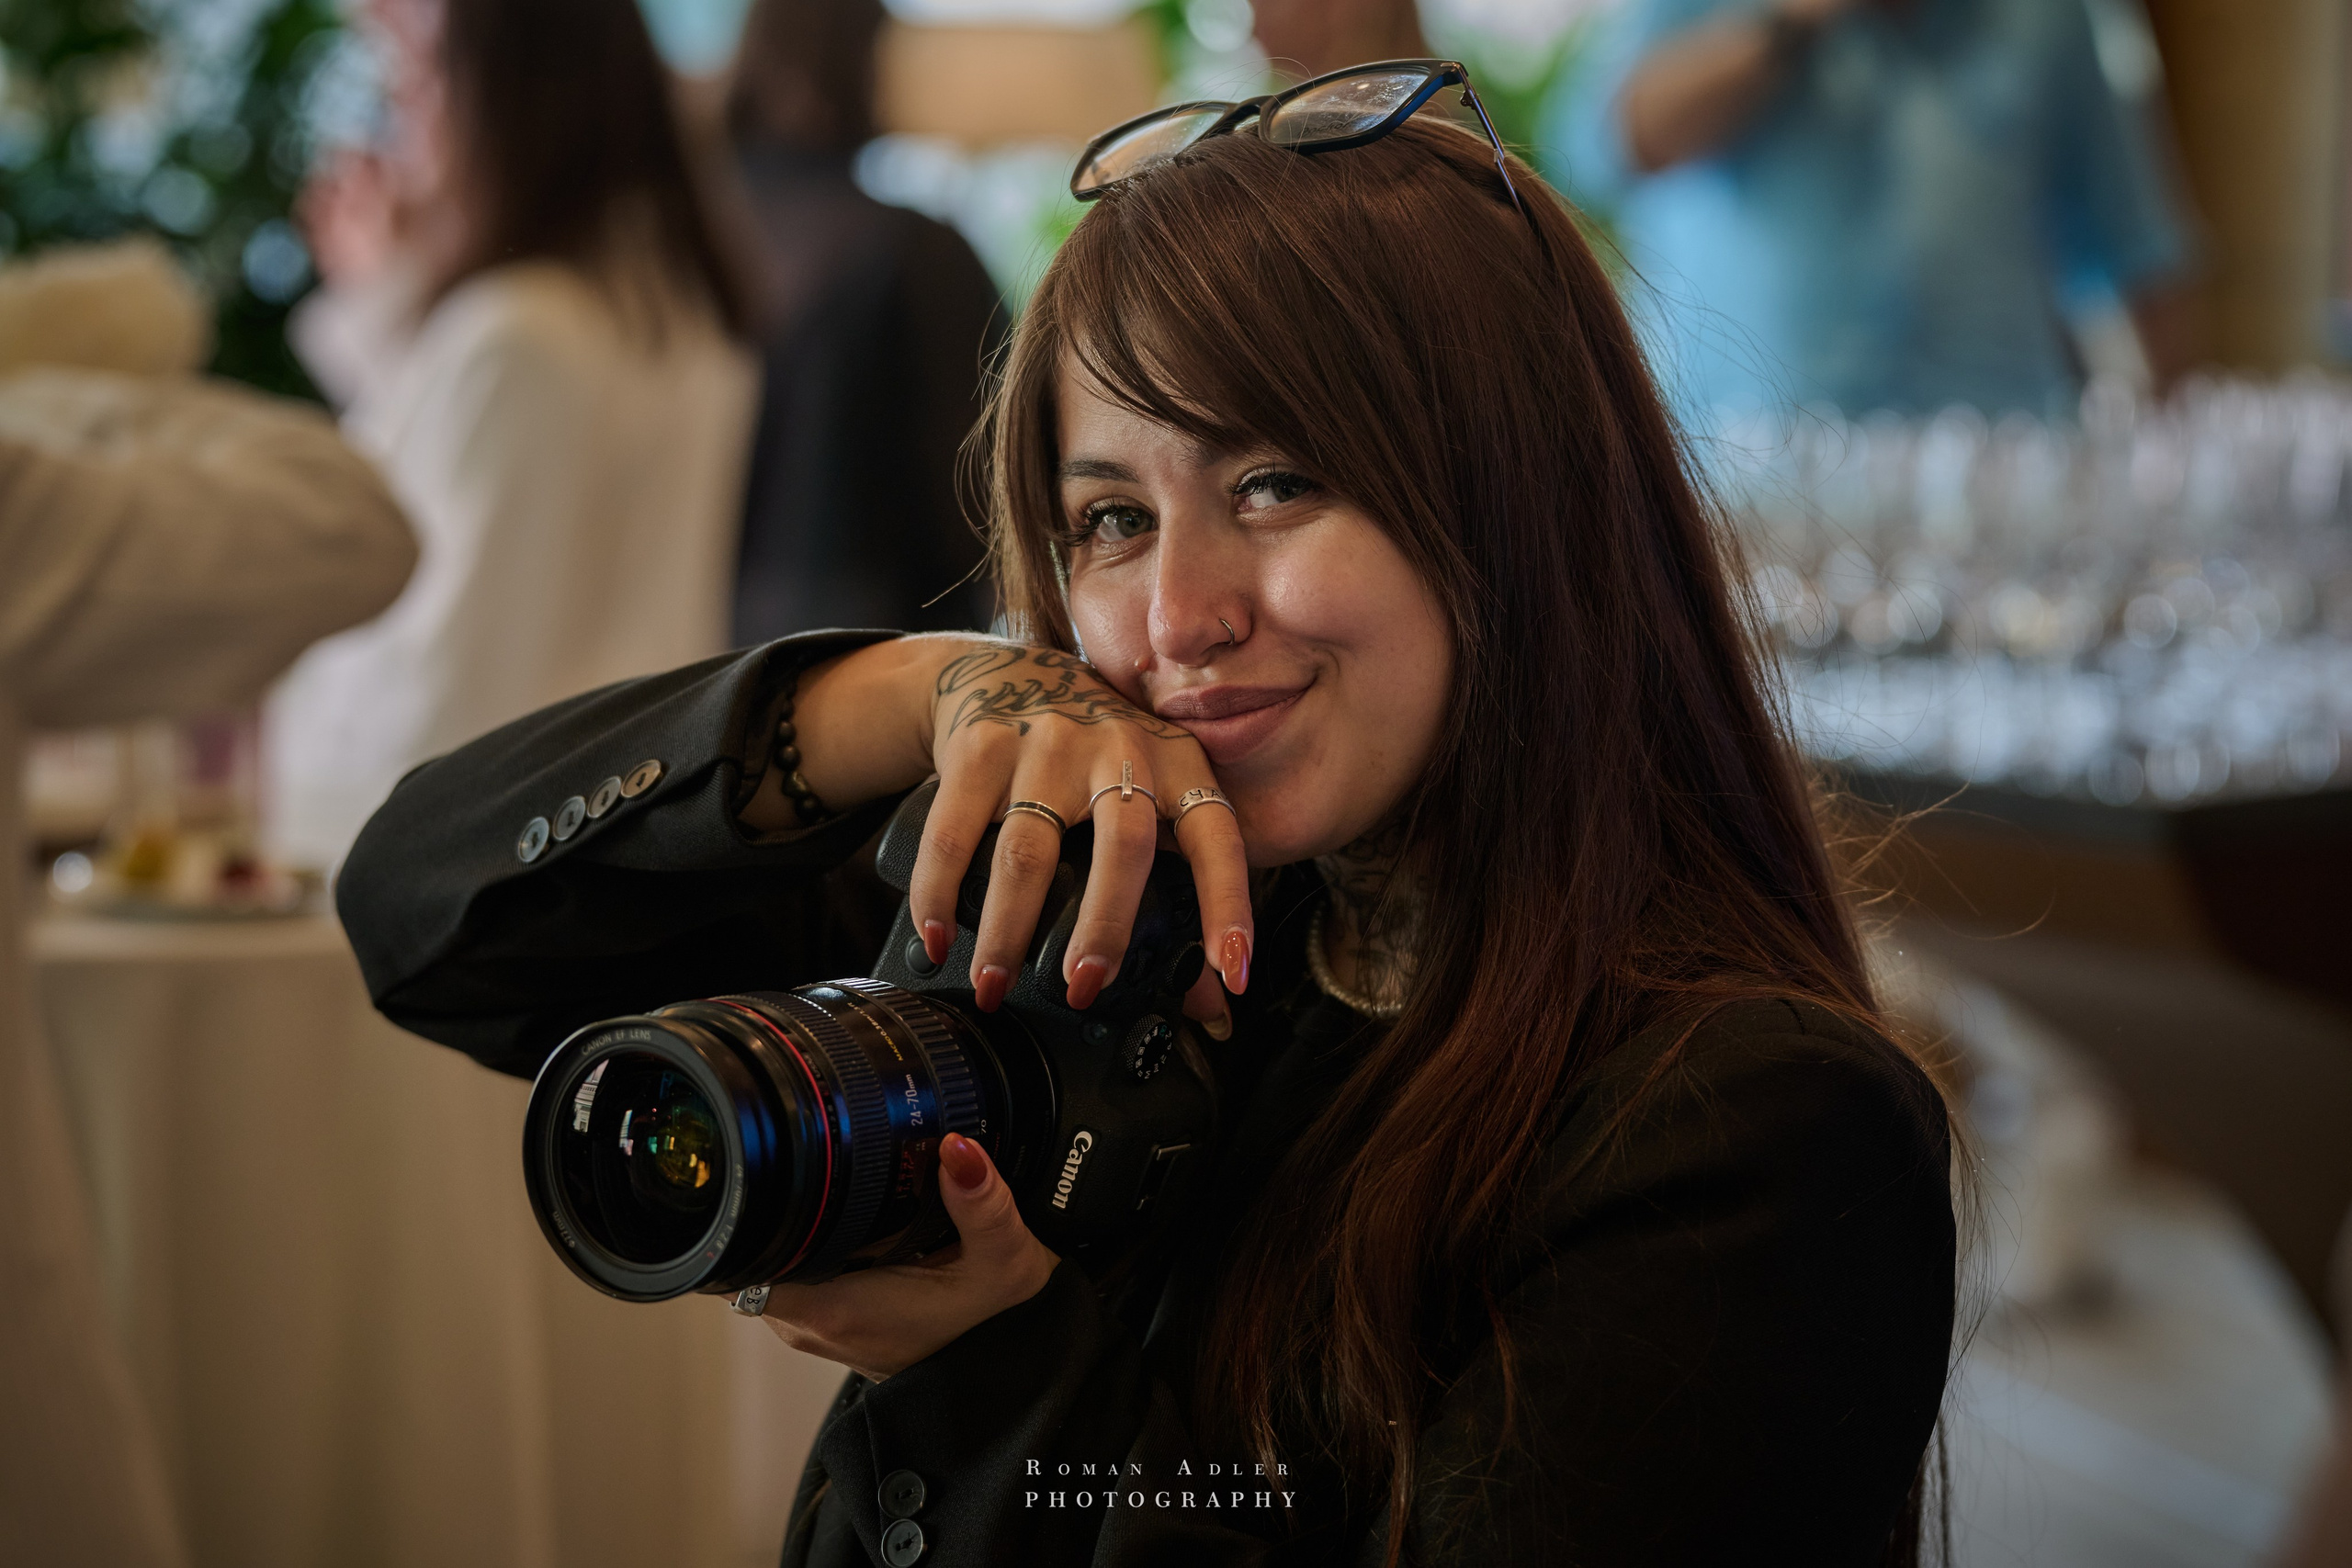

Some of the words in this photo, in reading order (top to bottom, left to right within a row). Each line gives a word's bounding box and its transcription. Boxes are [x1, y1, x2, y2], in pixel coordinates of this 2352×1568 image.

[581, 1032, 612, 1055] CANON
[630, 1028, 651, 1041] LENS
[905, 1074, 924, 1127] 24-70mm
[980, 1119, 988, 1135] 70
[1052, 1130, 1093, 1209] Canon
